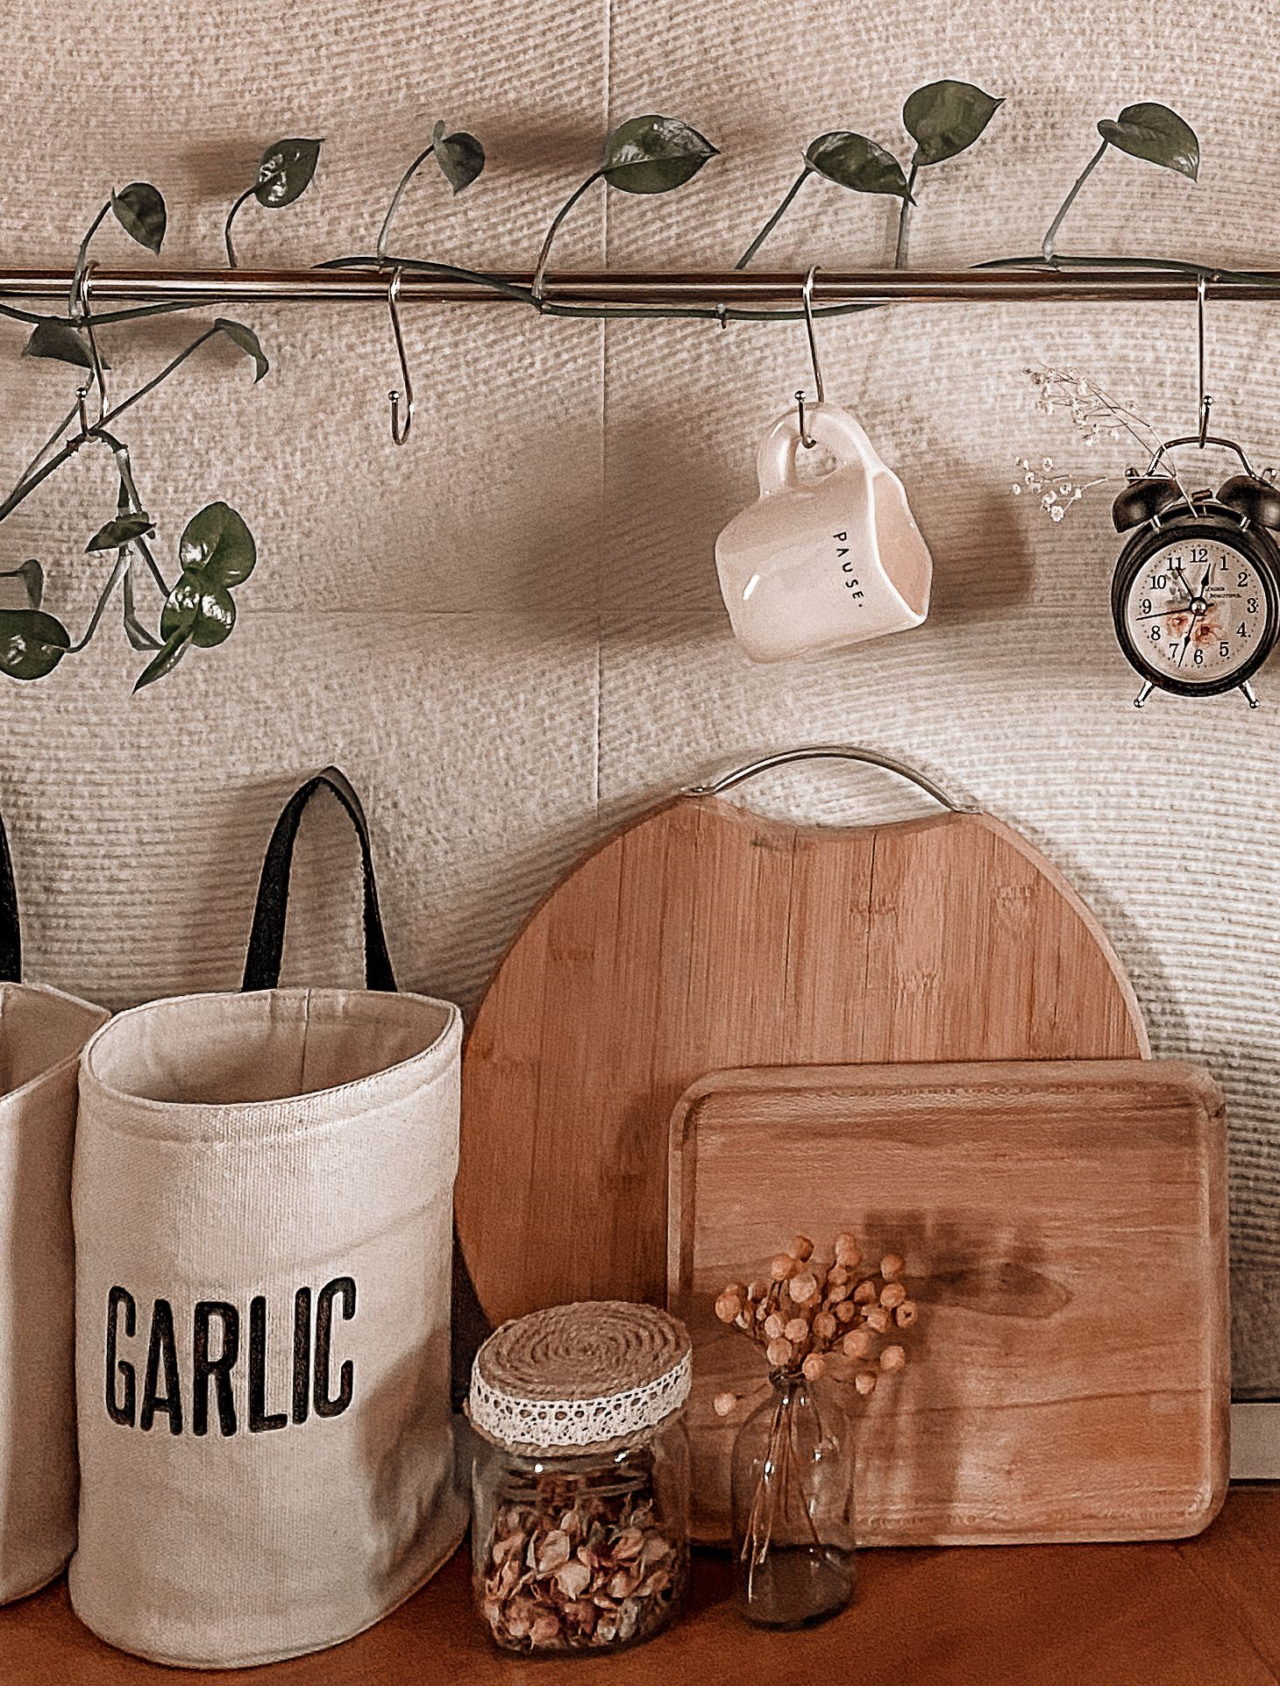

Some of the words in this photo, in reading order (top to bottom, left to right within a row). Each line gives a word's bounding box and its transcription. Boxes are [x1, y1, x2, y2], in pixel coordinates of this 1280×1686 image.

[1190, 549, 1208, 563] 12
[1220, 556, 1229, 571] 1
[1166, 557, 1186, 571] 11
[1150, 575, 1167, 589] 10
[1237, 572, 1249, 587] 2
[1142, 599, 1152, 614] 9
[1247, 598, 1257, 613] 3
[1151, 625, 1161, 641] 8
[1236, 622, 1247, 638] 4
[1169, 643, 1179, 659] 7
[1193, 649, 1204, 664] 6
[1219, 642, 1229, 657] 5
[105, 1276, 357, 1437] GARLIC
